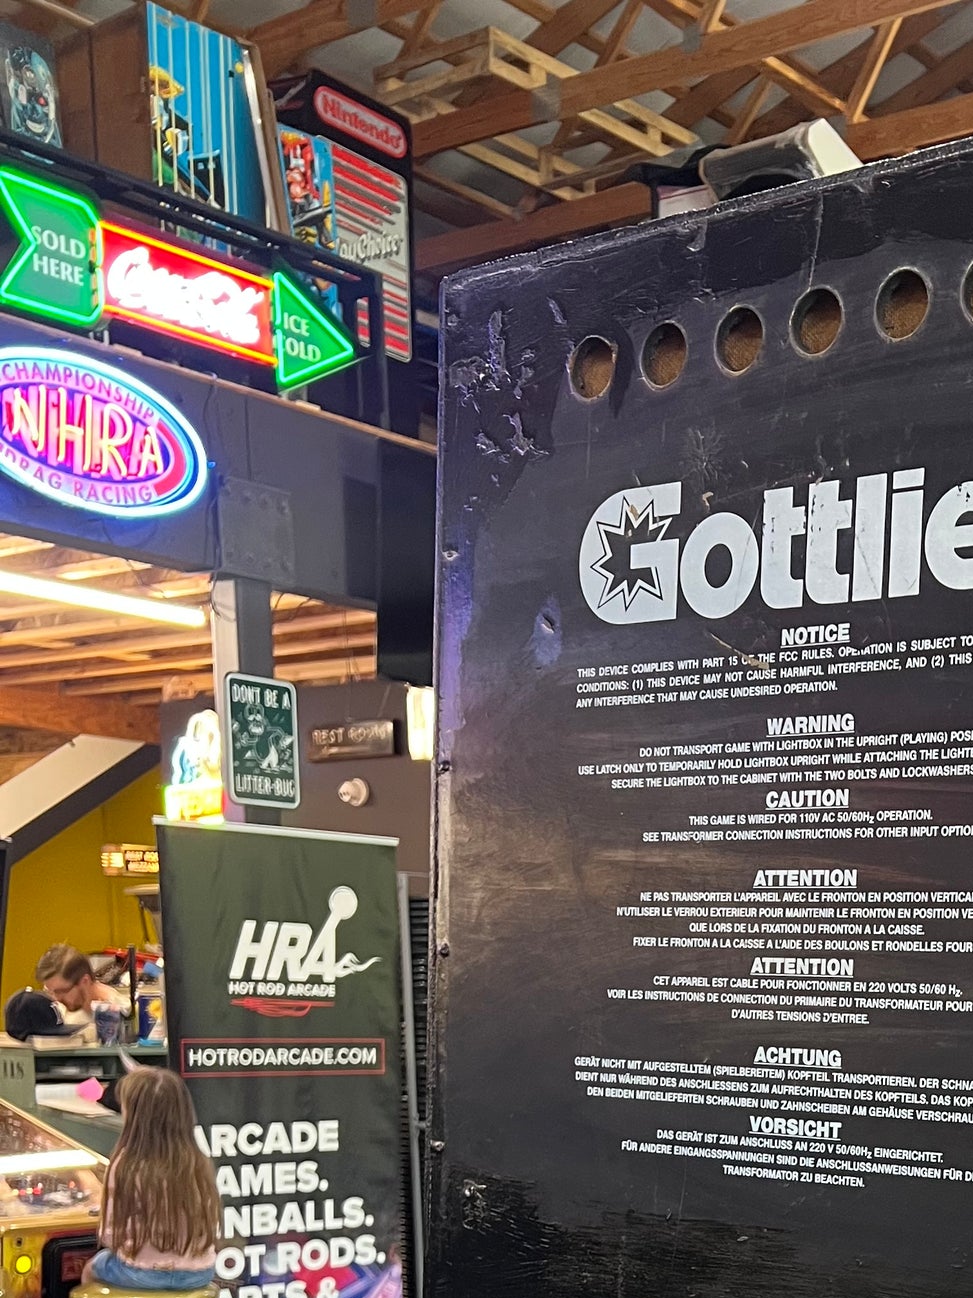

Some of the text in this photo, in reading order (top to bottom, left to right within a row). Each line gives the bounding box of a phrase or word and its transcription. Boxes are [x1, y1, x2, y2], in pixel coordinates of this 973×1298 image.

[323, 94, 401, 148] Nintendo
[31, 225, 86, 259] SOLD
[33, 253, 84, 286] HERE
[283, 312, 310, 337] ICE
[2, 362, 154, 420] CHAMPIONSHIP
[3, 383, 165, 480] NHRA
[73, 483, 152, 505] RACING
[782, 623, 850, 645] NOTICE
[577, 667, 596, 678] THIS
[598, 664, 629, 676] DEVICE
[631, 660, 674, 674] COMPLIES
[677, 658, 699, 670] WITH
[702, 656, 725, 668] PART
[728, 654, 738, 666] 15
[757, 651, 776, 663] THE
[779, 649, 798, 662] FCC
[801, 646, 835, 660] RULES.
[896, 640, 907, 652] IS
[910, 636, 957, 651] SUBJECT
[577, 679, 629, 693] CONDITIONS:
[632, 678, 644, 689] (1)
[646, 676, 666, 688] THIS
[669, 673, 700, 686] DEVICE
[703, 672, 722, 684] MAY
[724, 670, 744, 682] NOT
[746, 667, 777, 680] CAUSE
[780, 663, 825, 678] HARMFUL
[827, 657, 902, 674] INTERFERENCE,
[905, 655, 927, 668] AND
[931, 654, 945, 666] (2)
[948, 652, 973, 665] THIS
[264, 688, 279, 709] BE
[282, 691, 291, 710] A
[767, 714, 854, 735] WARNING
[640, 747, 653, 757] DO
[653, 746, 672, 757] NOT
[672, 743, 724, 756] TRANSPORT
[724, 742, 751, 753] GAME
[751, 740, 775, 752] WITH
[776, 738, 823, 751] LIGHTBOX
[823, 737, 834, 748] IN
[835, 736, 855, 748] THE
[856, 734, 899, 747] UPRIGHT
[900, 731, 948, 744] (PLAYING)
[766, 789, 849, 807] CAUTION
[689, 815, 709, 826] THIS
[710, 815, 736, 825] GAME
[737, 815, 746, 825] IS
[747, 814, 777, 824] WIRED
[778, 813, 797, 824] FOR
[799, 812, 821, 823] 110V
[821, 812, 836, 823] AC
[876, 810, 932, 821] OPERATION.
[754, 869, 857, 887] ATTENTION
[641, 892, 652, 902] NE
[653, 892, 670, 902] PAS
[670, 892, 732, 902] TRANSPORTER
[733, 892, 781, 902] L'APPAREIL
[782, 892, 806, 902] AVEC
[808, 892, 820, 902] LE
[821, 892, 866, 902] FRONTON
[867, 892, 881, 902] EN
[883, 892, 929, 902] POSITION
[229, 900, 350, 983] HRA
[751, 957, 854, 976] ATTENTION
[229, 981, 335, 997] HOT ROD ARCADE
[188, 1047, 377, 1067] HOTRODARCADE.COM
[754, 1046, 842, 1067] ACHTUNG
[601, 1058, 626, 1069] NICHT
[627, 1059, 642, 1070] MIT
[642, 1060, 711, 1075] AUFGESTELLTEM
[712, 1064, 786, 1079] (SPIELBEREITEM)
[787, 1069, 831, 1082] KOPFTEIL
[831, 1071, 918, 1087] TRANSPORTIEREN.
[919, 1076, 940, 1088] DER
[750, 1115, 842, 1138] VORSICHT
[216, 1160, 329, 1198] AMES.
[217, 1196, 374, 1239] NBALLS.
[215, 1233, 386, 1280] OT RODS.
